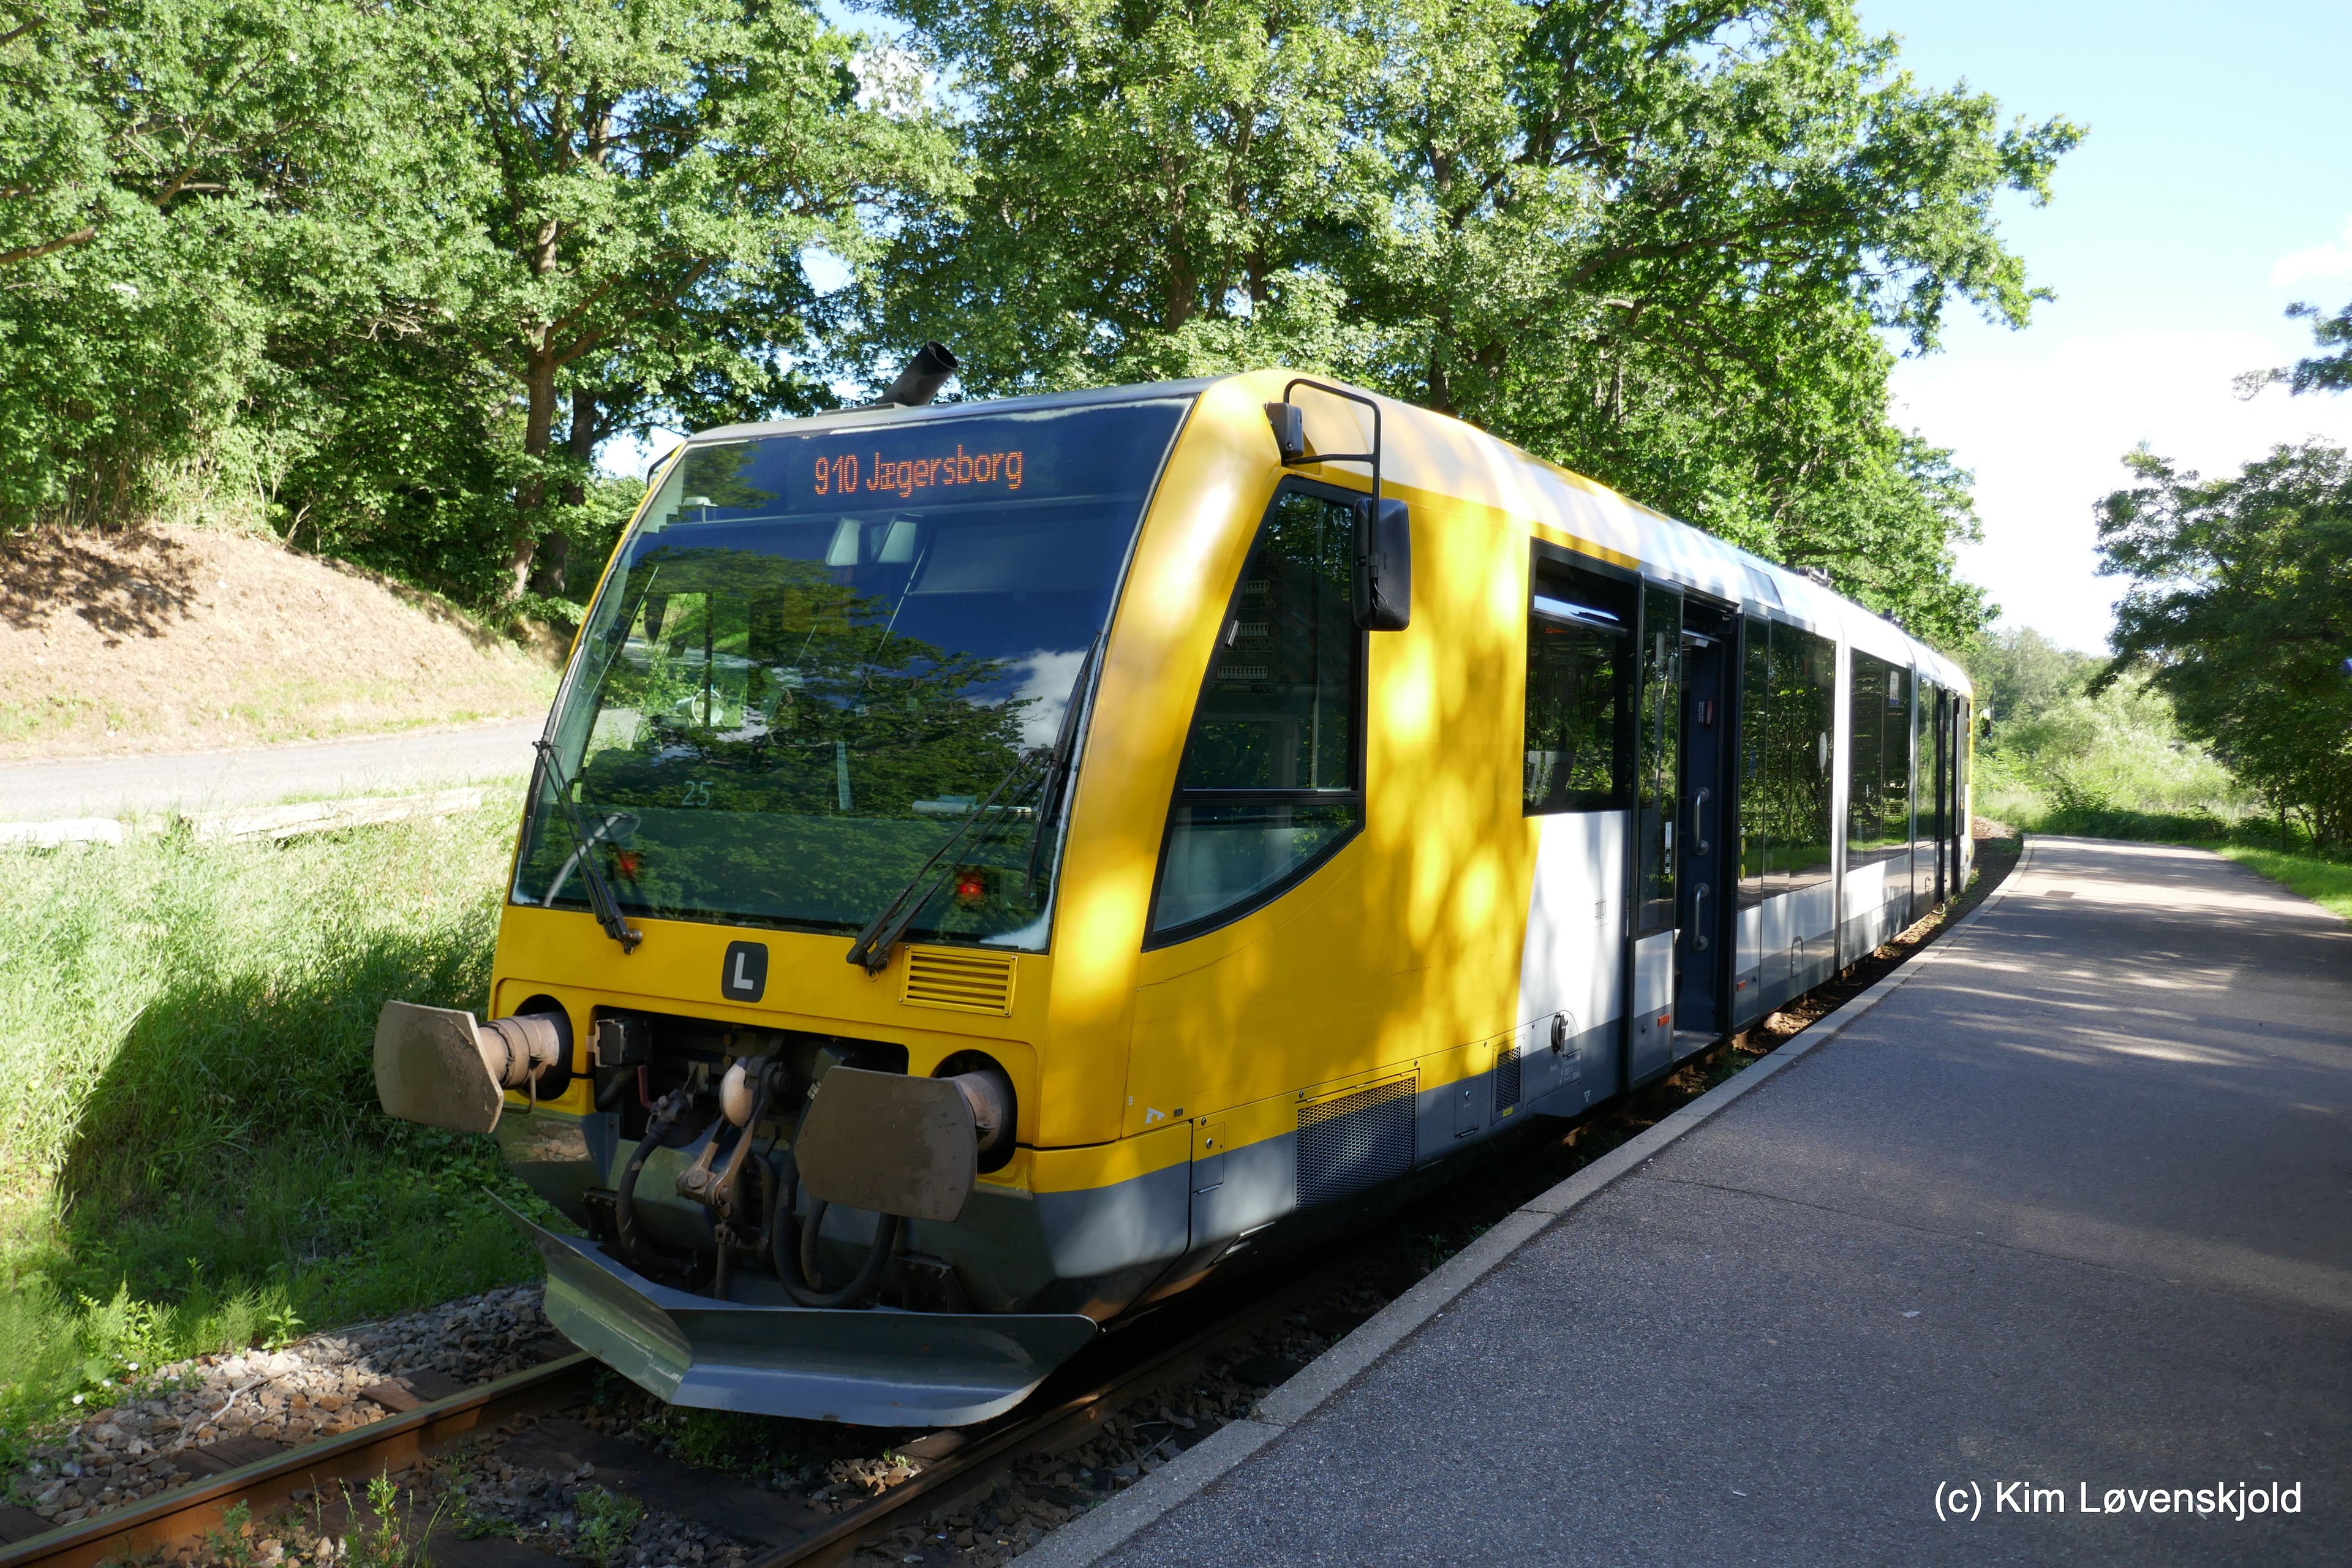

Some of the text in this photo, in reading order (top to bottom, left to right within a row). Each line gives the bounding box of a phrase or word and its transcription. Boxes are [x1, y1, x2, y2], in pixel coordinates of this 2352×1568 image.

[815, 444, 1023, 498] 910 Jægersborg
[682, 780, 714, 807] 25
[733, 952, 754, 990] L
